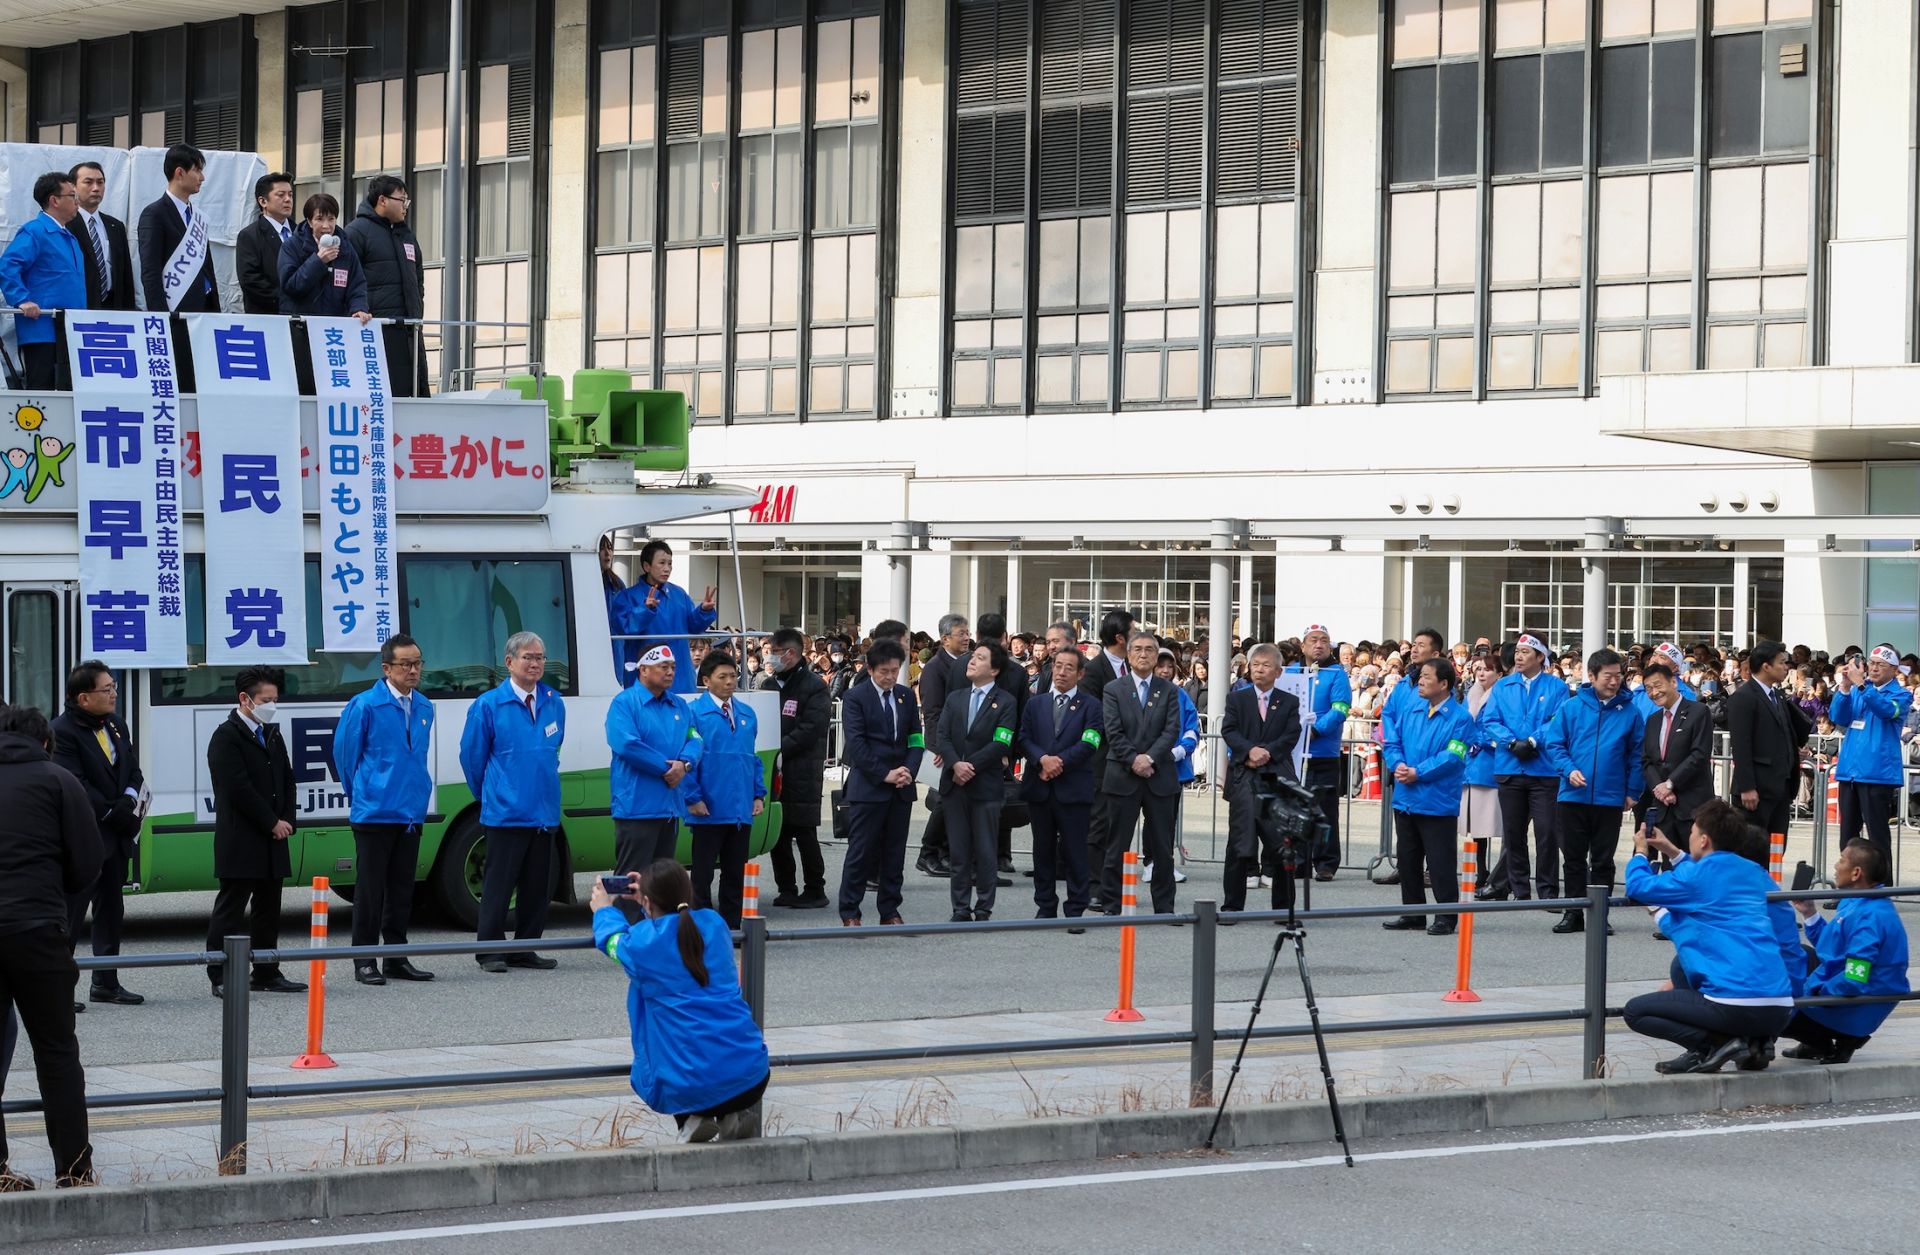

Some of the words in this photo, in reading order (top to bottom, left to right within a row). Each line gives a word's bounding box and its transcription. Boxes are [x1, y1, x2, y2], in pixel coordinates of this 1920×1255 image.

[73, 322, 149, 652] 高市早苗
[144, 316, 181, 617] 内閣総理大臣・自由民主党総裁
[214, 325, 286, 649] 自民党
[324, 327, 351, 388] 支部長
[360, 328, 391, 643] 自由民主党兵庫県衆議院選挙区第十一支部
[749, 485, 795, 523] H&M
[329, 402, 365, 635] 山田もとやす
